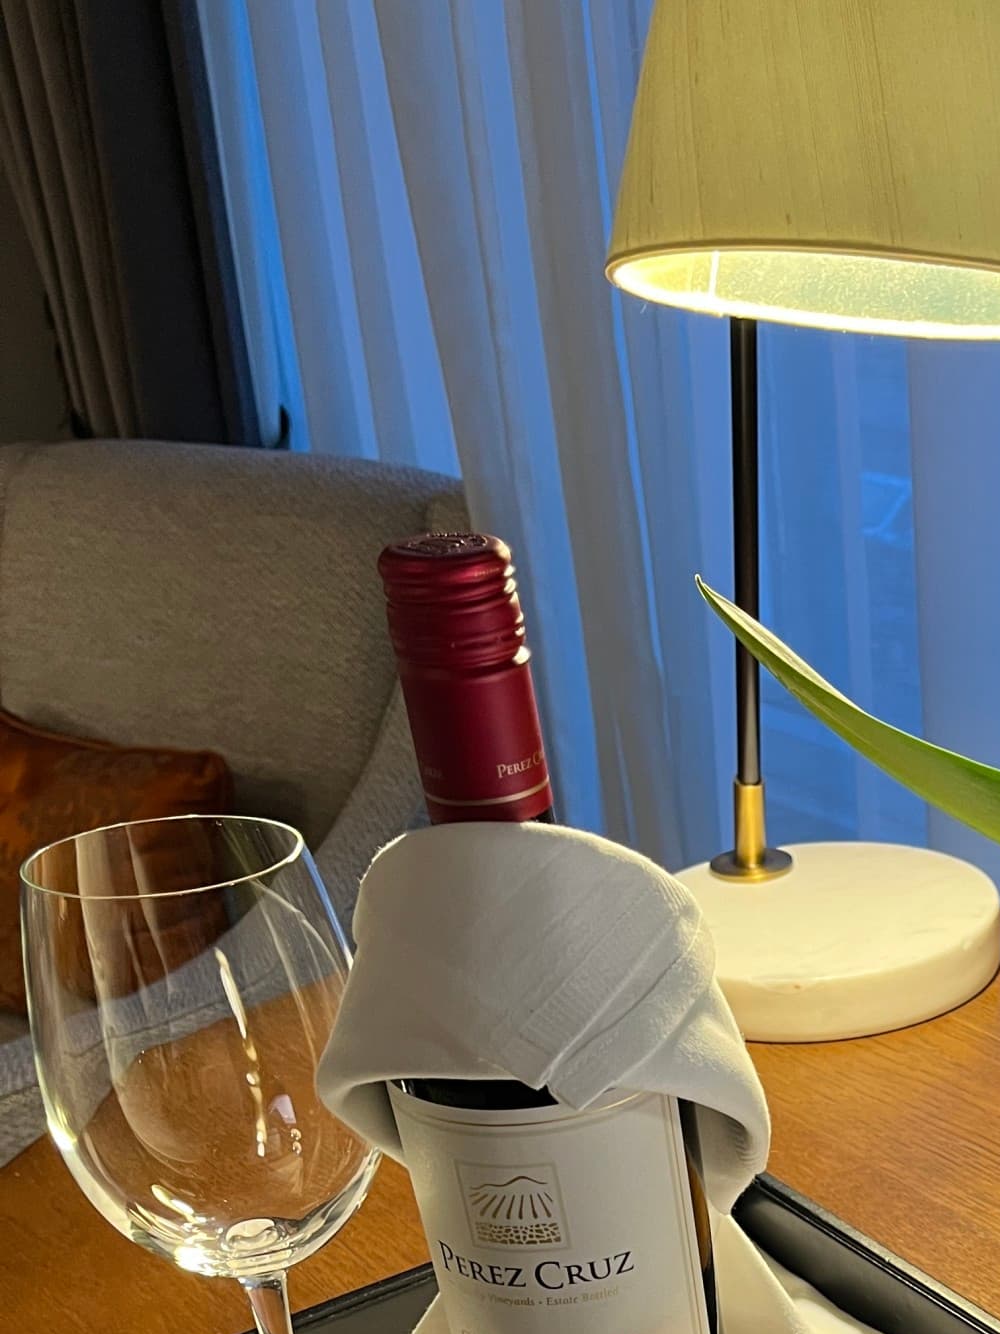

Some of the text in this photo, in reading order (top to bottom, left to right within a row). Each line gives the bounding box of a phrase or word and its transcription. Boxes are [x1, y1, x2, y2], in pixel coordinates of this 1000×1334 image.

[497, 758, 531, 778] PEREZ
[438, 1240, 526, 1288] PEREZ
[534, 1251, 635, 1290] CRUZ
[546, 1296, 579, 1306] Estate
